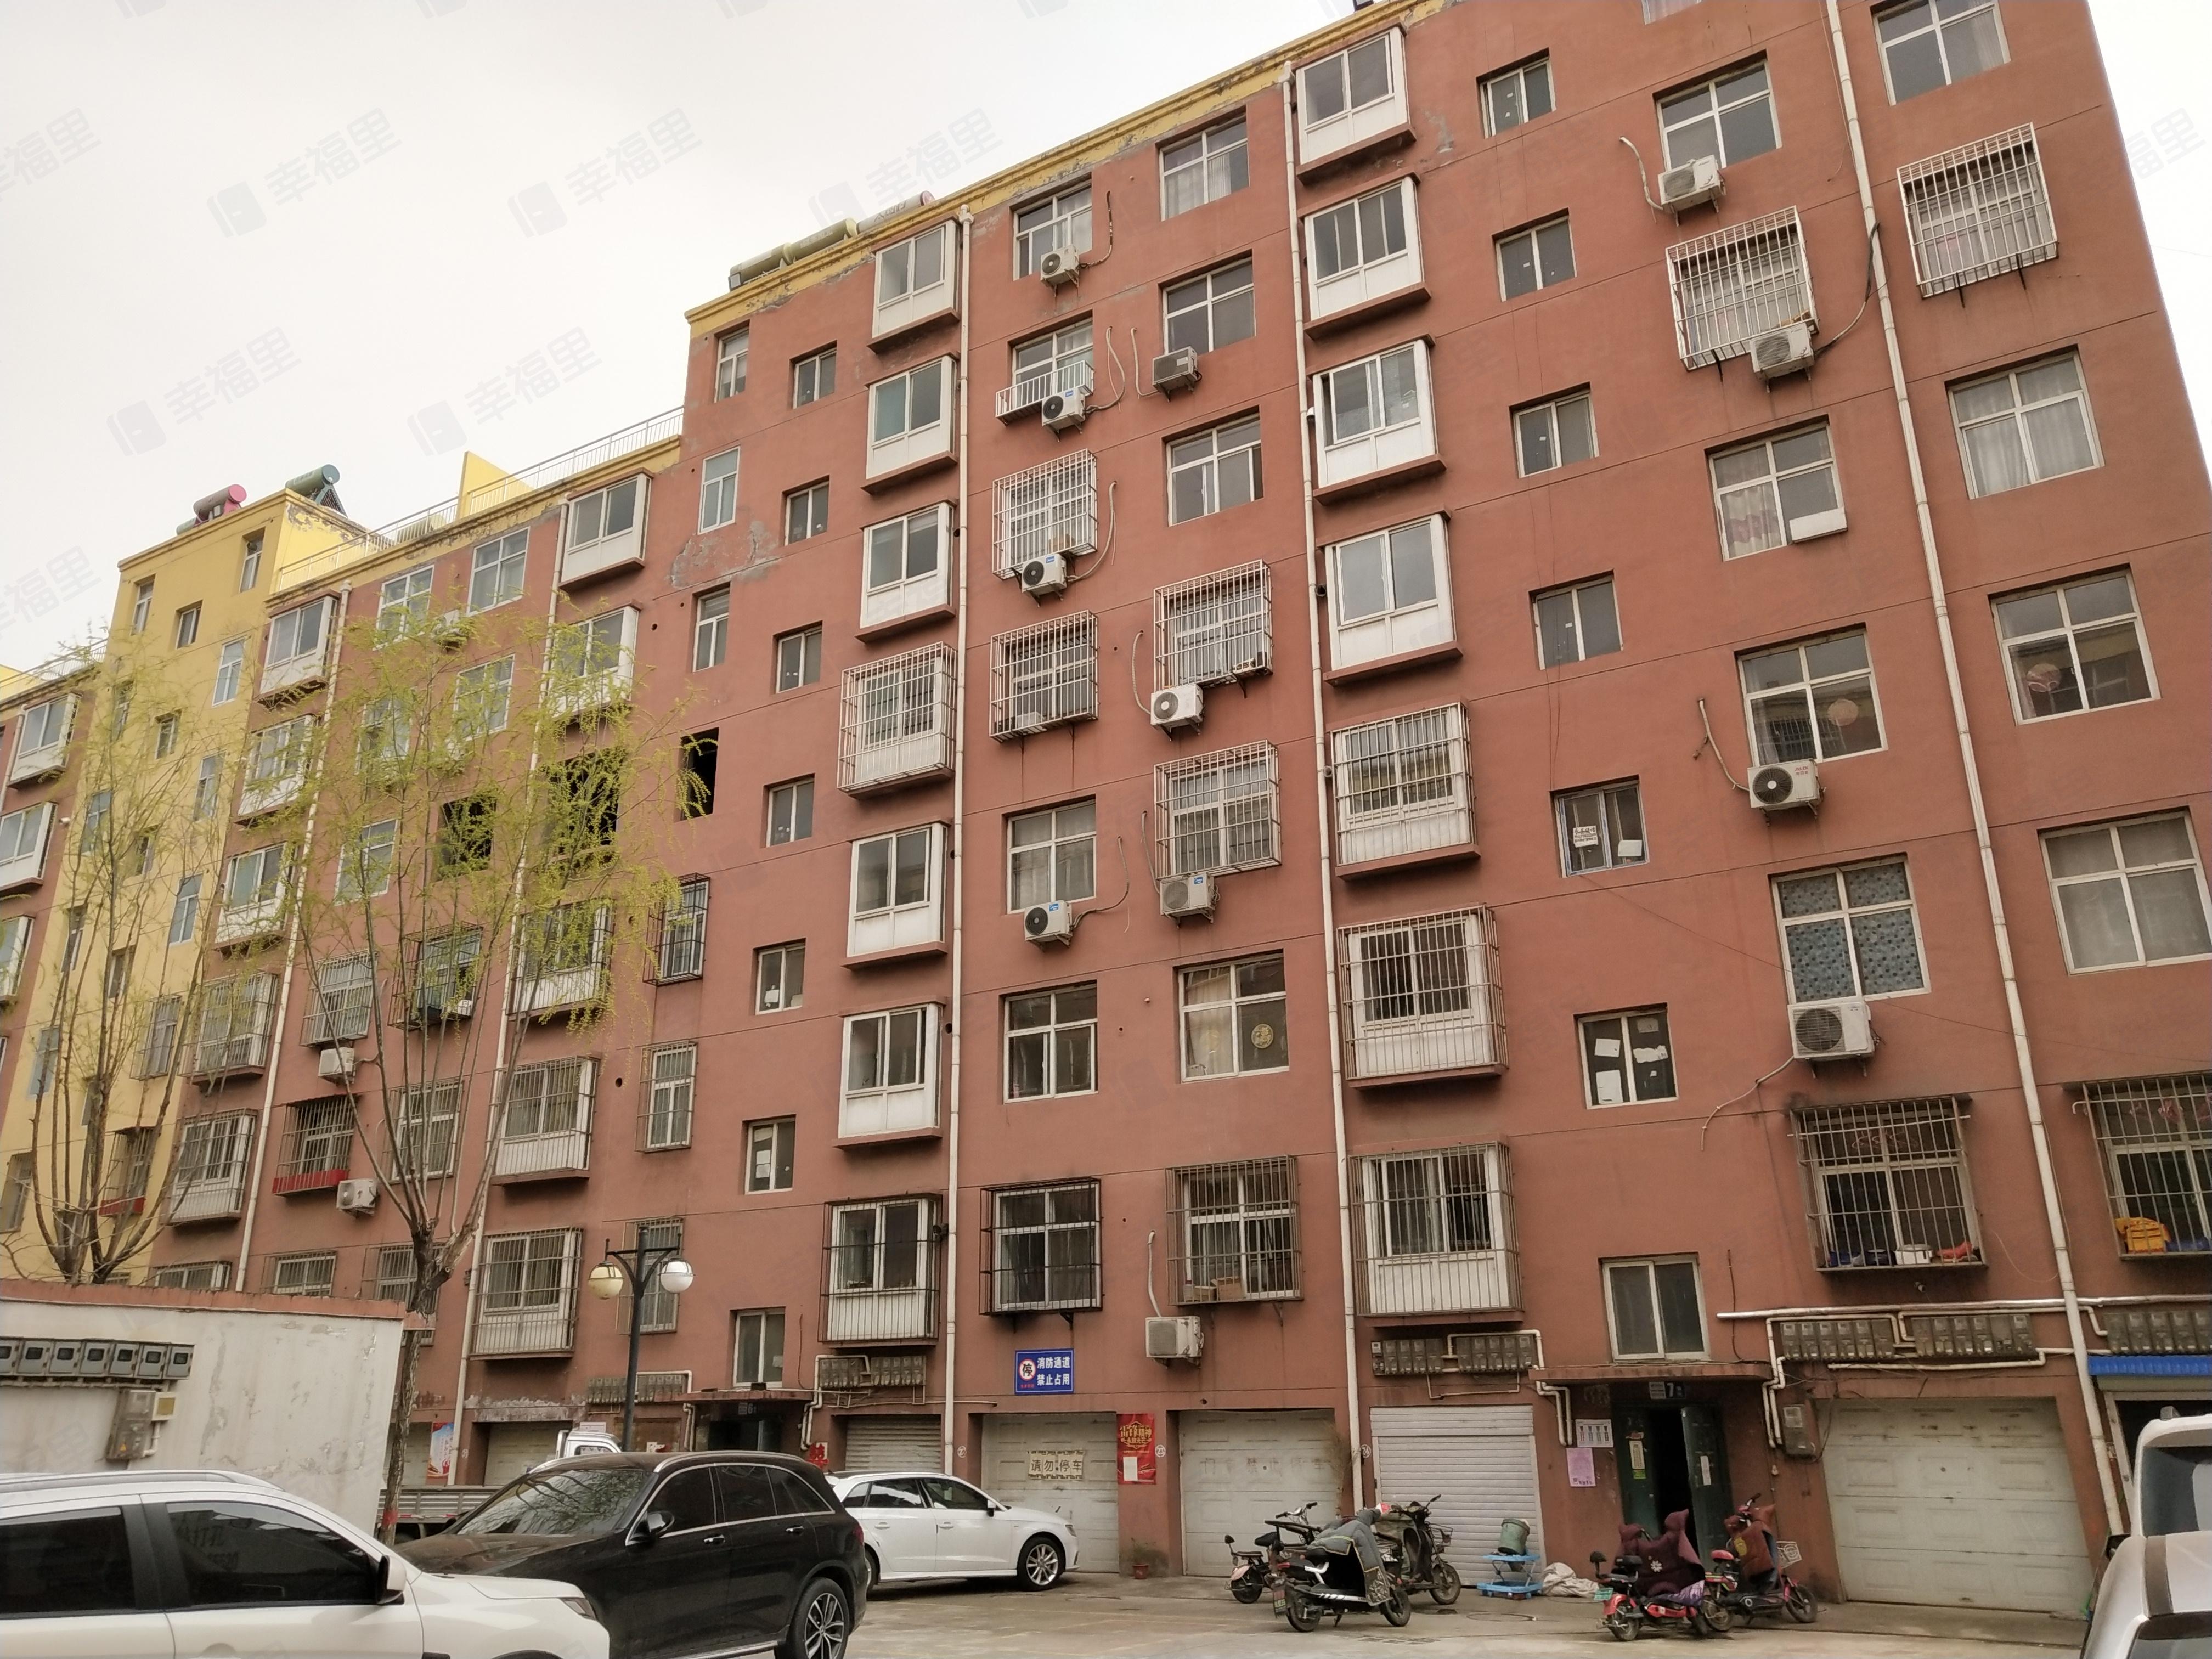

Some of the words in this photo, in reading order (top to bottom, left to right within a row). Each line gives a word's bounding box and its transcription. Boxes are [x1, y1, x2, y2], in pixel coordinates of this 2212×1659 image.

[1037, 1356, 1070, 1369] 消防通道
[1022, 1363, 1033, 1376] 停
[1036, 1373, 1070, 1386] 禁止占用
[1031, 1459, 1084, 1472] 请勿停车
